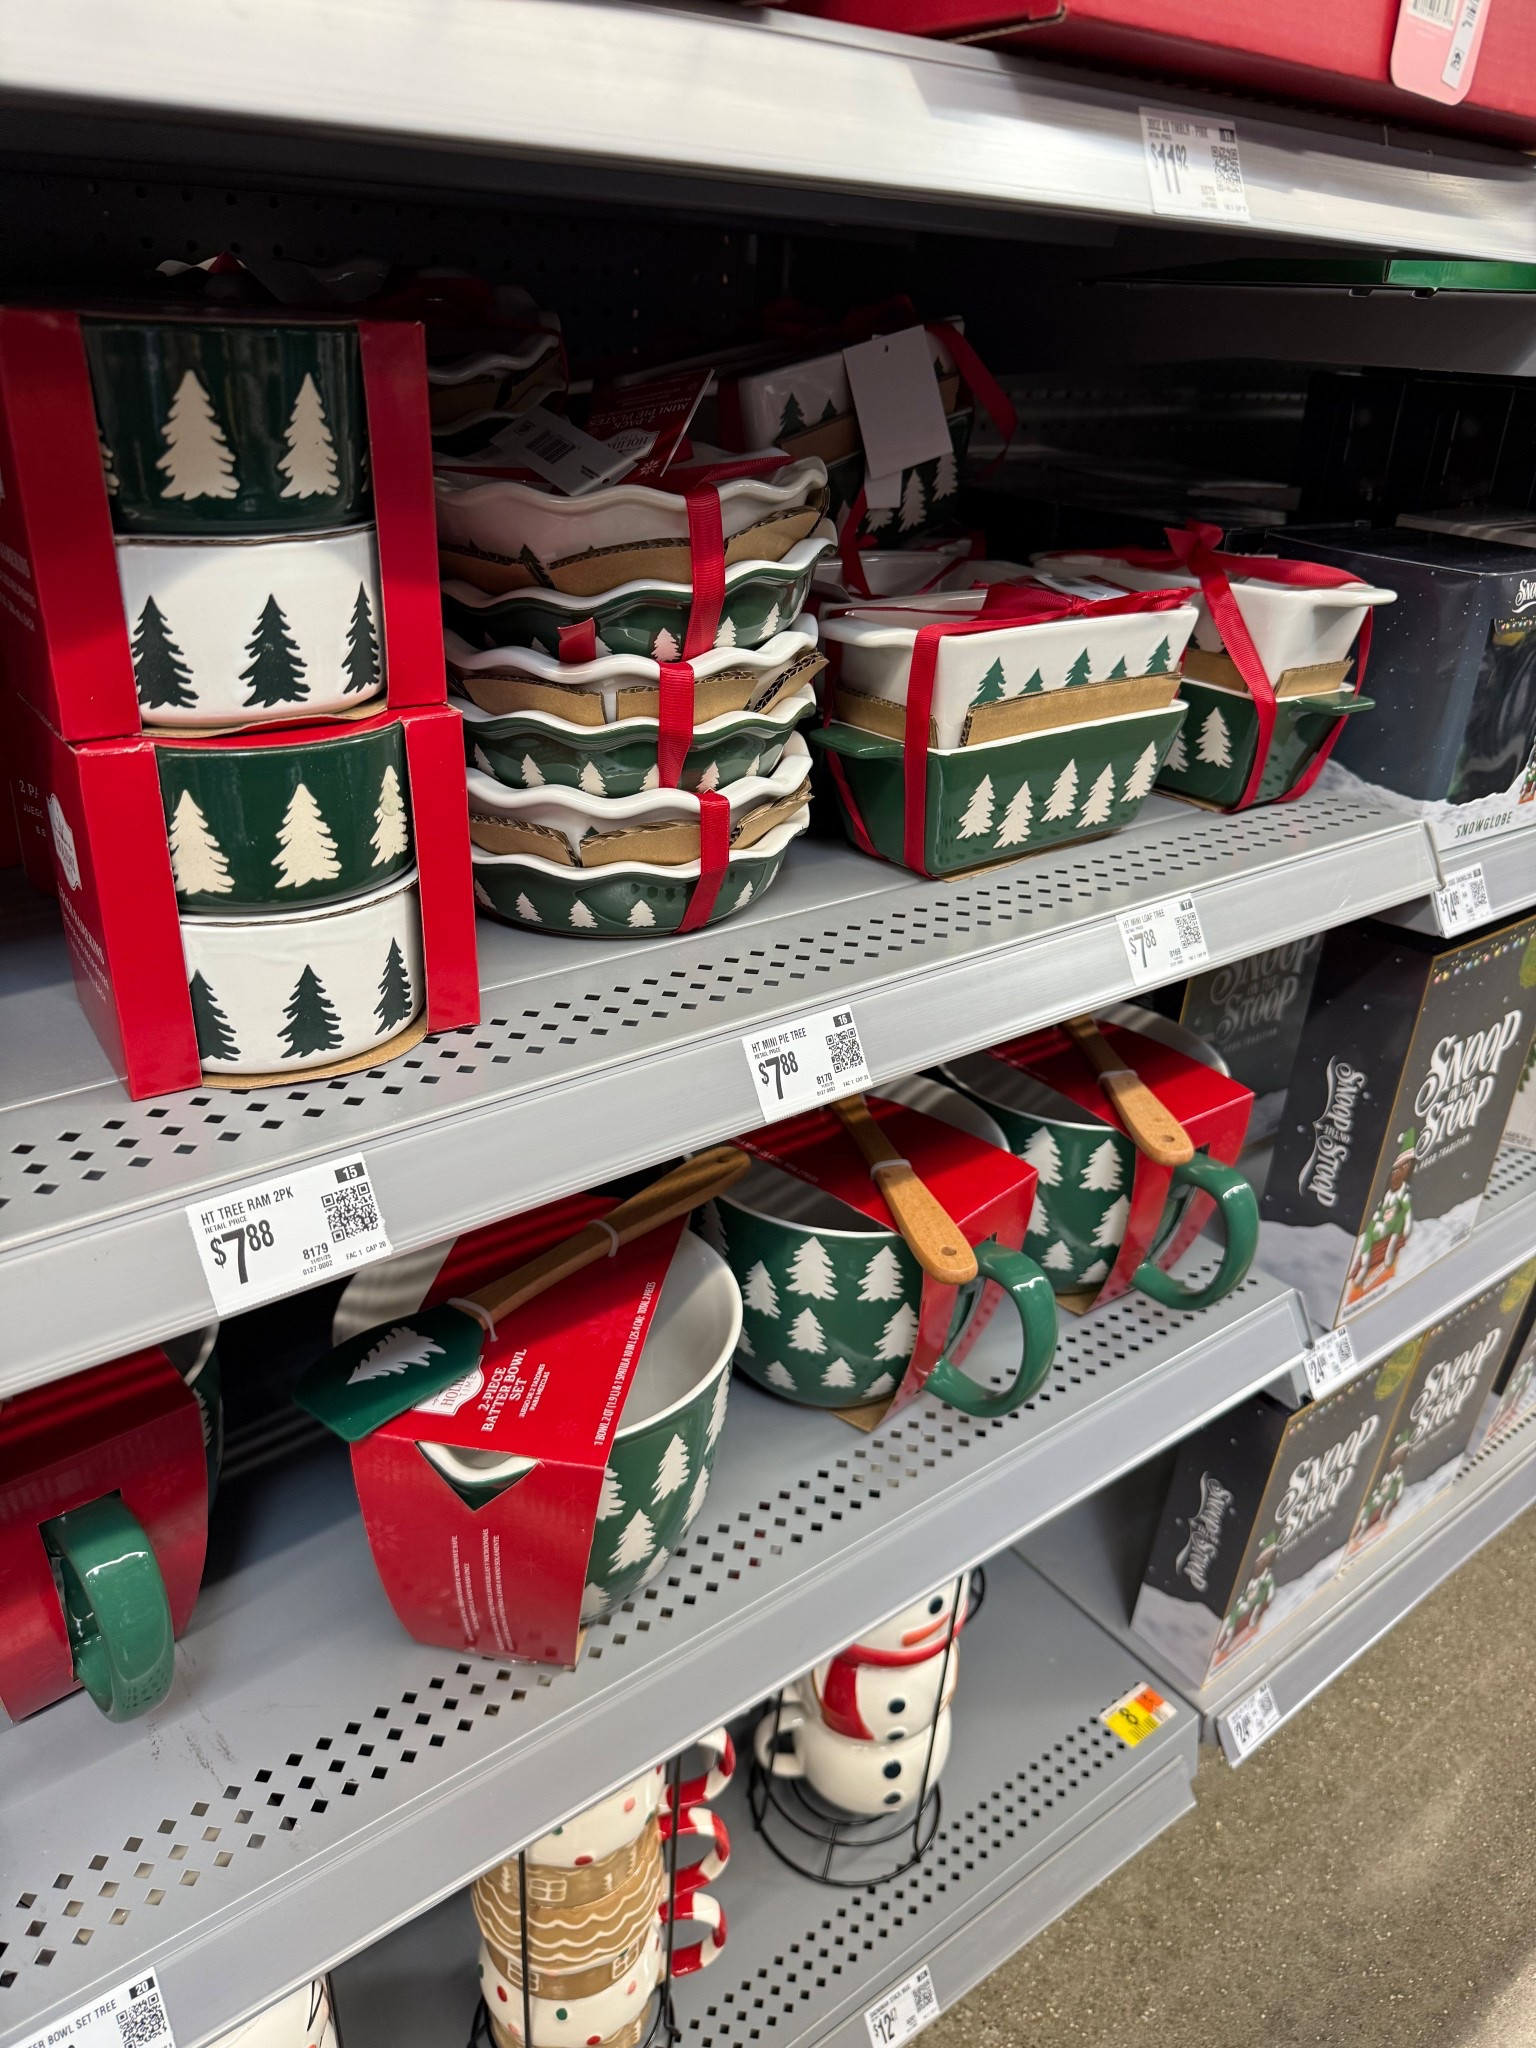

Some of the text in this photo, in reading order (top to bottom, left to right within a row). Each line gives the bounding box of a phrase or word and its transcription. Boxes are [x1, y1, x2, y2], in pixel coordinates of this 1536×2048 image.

[637, 408, 656, 417] PIE
[659, 402, 688, 414] MINI
[589, 412, 633, 426] PLATES
[613, 416, 655, 430] 2-PACK
[607, 437, 648, 450] HOLIDA
[1455, 811, 1513, 838] SNOWGLOBE
[1122, 920, 1130, 928] HT
[1142, 912, 1152, 922] LOAF
[1153, 909, 1165, 920] TREE
[838, 1014, 848, 1025] 16
[752, 1028, 806, 1053] HT MINI PIE TREE
[754, 1046, 780, 1060] RETAIL PRICE
[1415, 1009, 1522, 1118] SNOOP
[816, 1072, 832, 1084] 8170
[1449, 1076, 1477, 1102] ON THE
[1415, 1076, 1496, 1160] STOOP
[342, 1166, 358, 1180] 15
[201, 1186, 294, 1226] HT TREE RAM 2PK
[205, 1216, 248, 1234] RETAIL PRICE
[302, 1242, 329, 1260] 8179
[346, 1251, 357, 1260] FAC
[366, 1244, 378, 1253] CAP
[303, 1260, 333, 1276] 0127-0002
[643, 1282, 656, 1296] PIECES
[637, 1300, 650, 1314] TOTAL
[615, 1358, 632, 1381] SPATULA
[1410, 1327, 1502, 1422] SNOOP
[440, 1375, 468, 1406] HOLI
[460, 1374, 477, 1397] TIME
[477, 1367, 506, 1412] 2-PIECE
[480, 1348, 527, 1432] BATTER BOWL
[509, 1378, 527, 1402] SET
[518, 1399, 532, 1418] JUEGO
[531, 1364, 546, 1388] TAZONES
[529, 1371, 550, 1412] PARA MEZCLAS
[606, 1396, 618, 1408] (1.9
[603, 1408, 614, 1416] QT
[594, 1422, 610, 1442] BOWL
[1275, 1414, 1380, 1525] SNOOP
[1119, 1707, 1138, 1726] 8
[135, 1981, 149, 1996] 20
[48, 2025, 74, 2046] BOWL
[76, 2014, 92, 2030] SET
[94, 1999, 117, 2020] TREE
